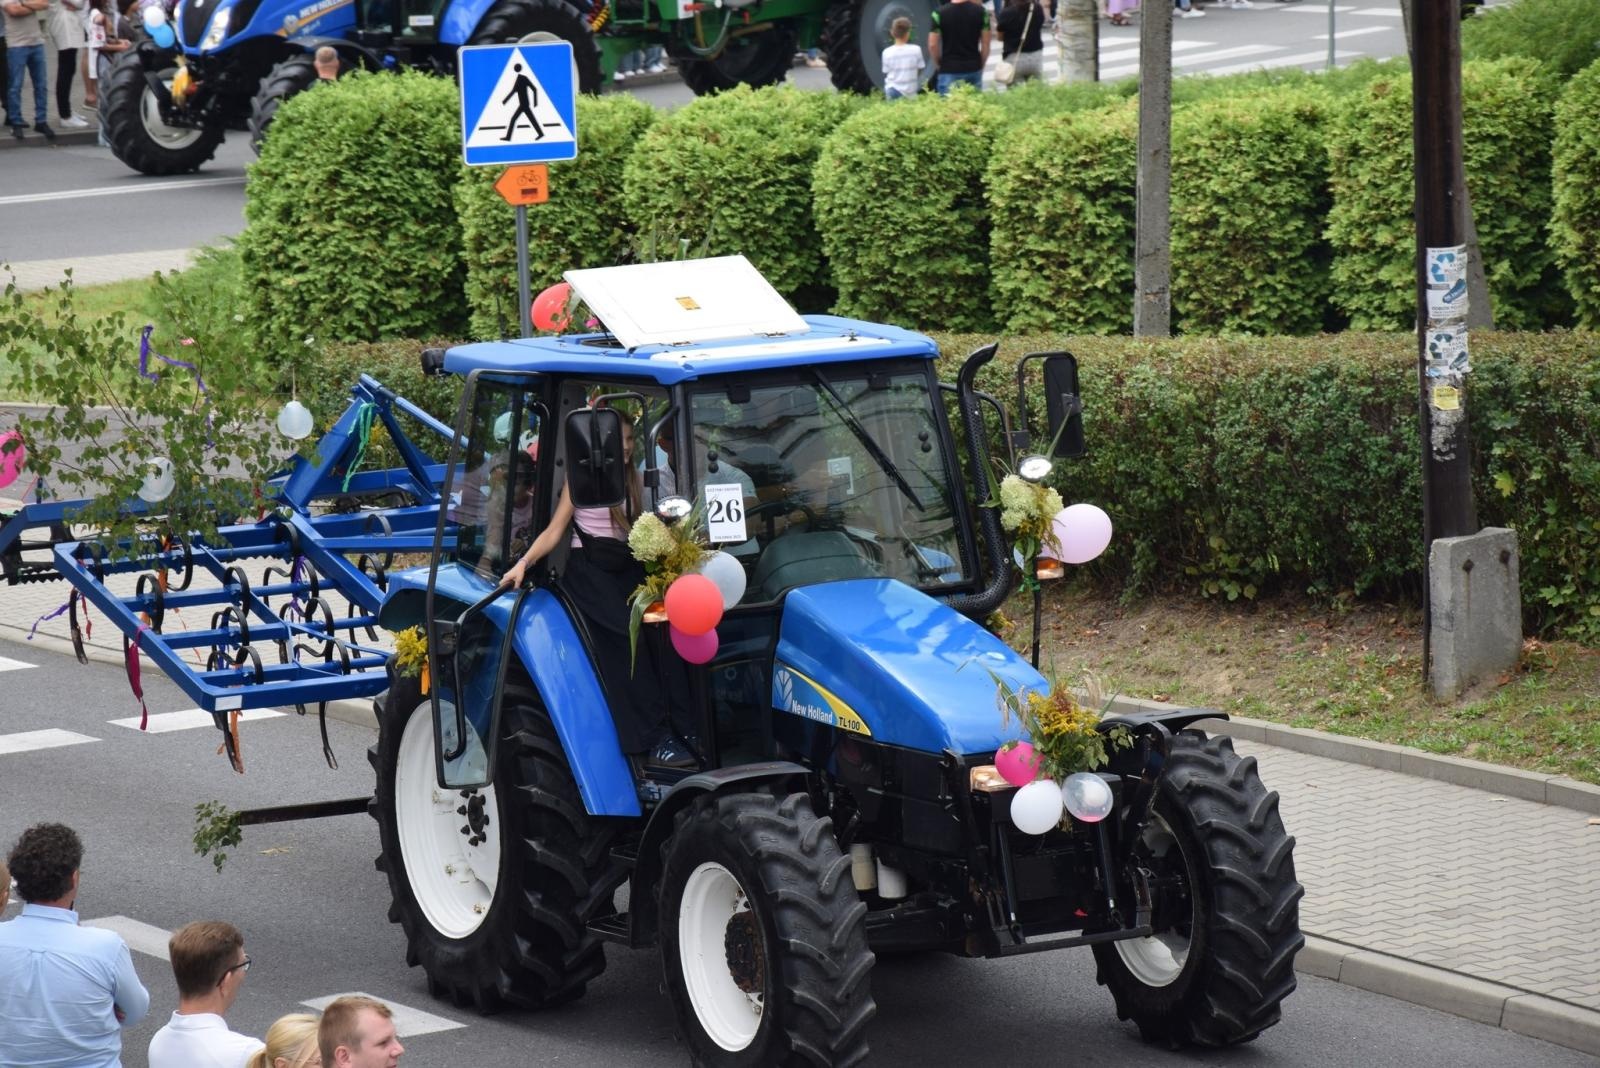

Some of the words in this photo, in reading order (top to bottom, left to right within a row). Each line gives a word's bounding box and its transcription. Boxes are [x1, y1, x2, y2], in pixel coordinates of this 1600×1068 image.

[709, 499, 741, 523] 26
[792, 700, 807, 716] New
[808, 704, 833, 724] Holland
[839, 716, 861, 731] TL100
